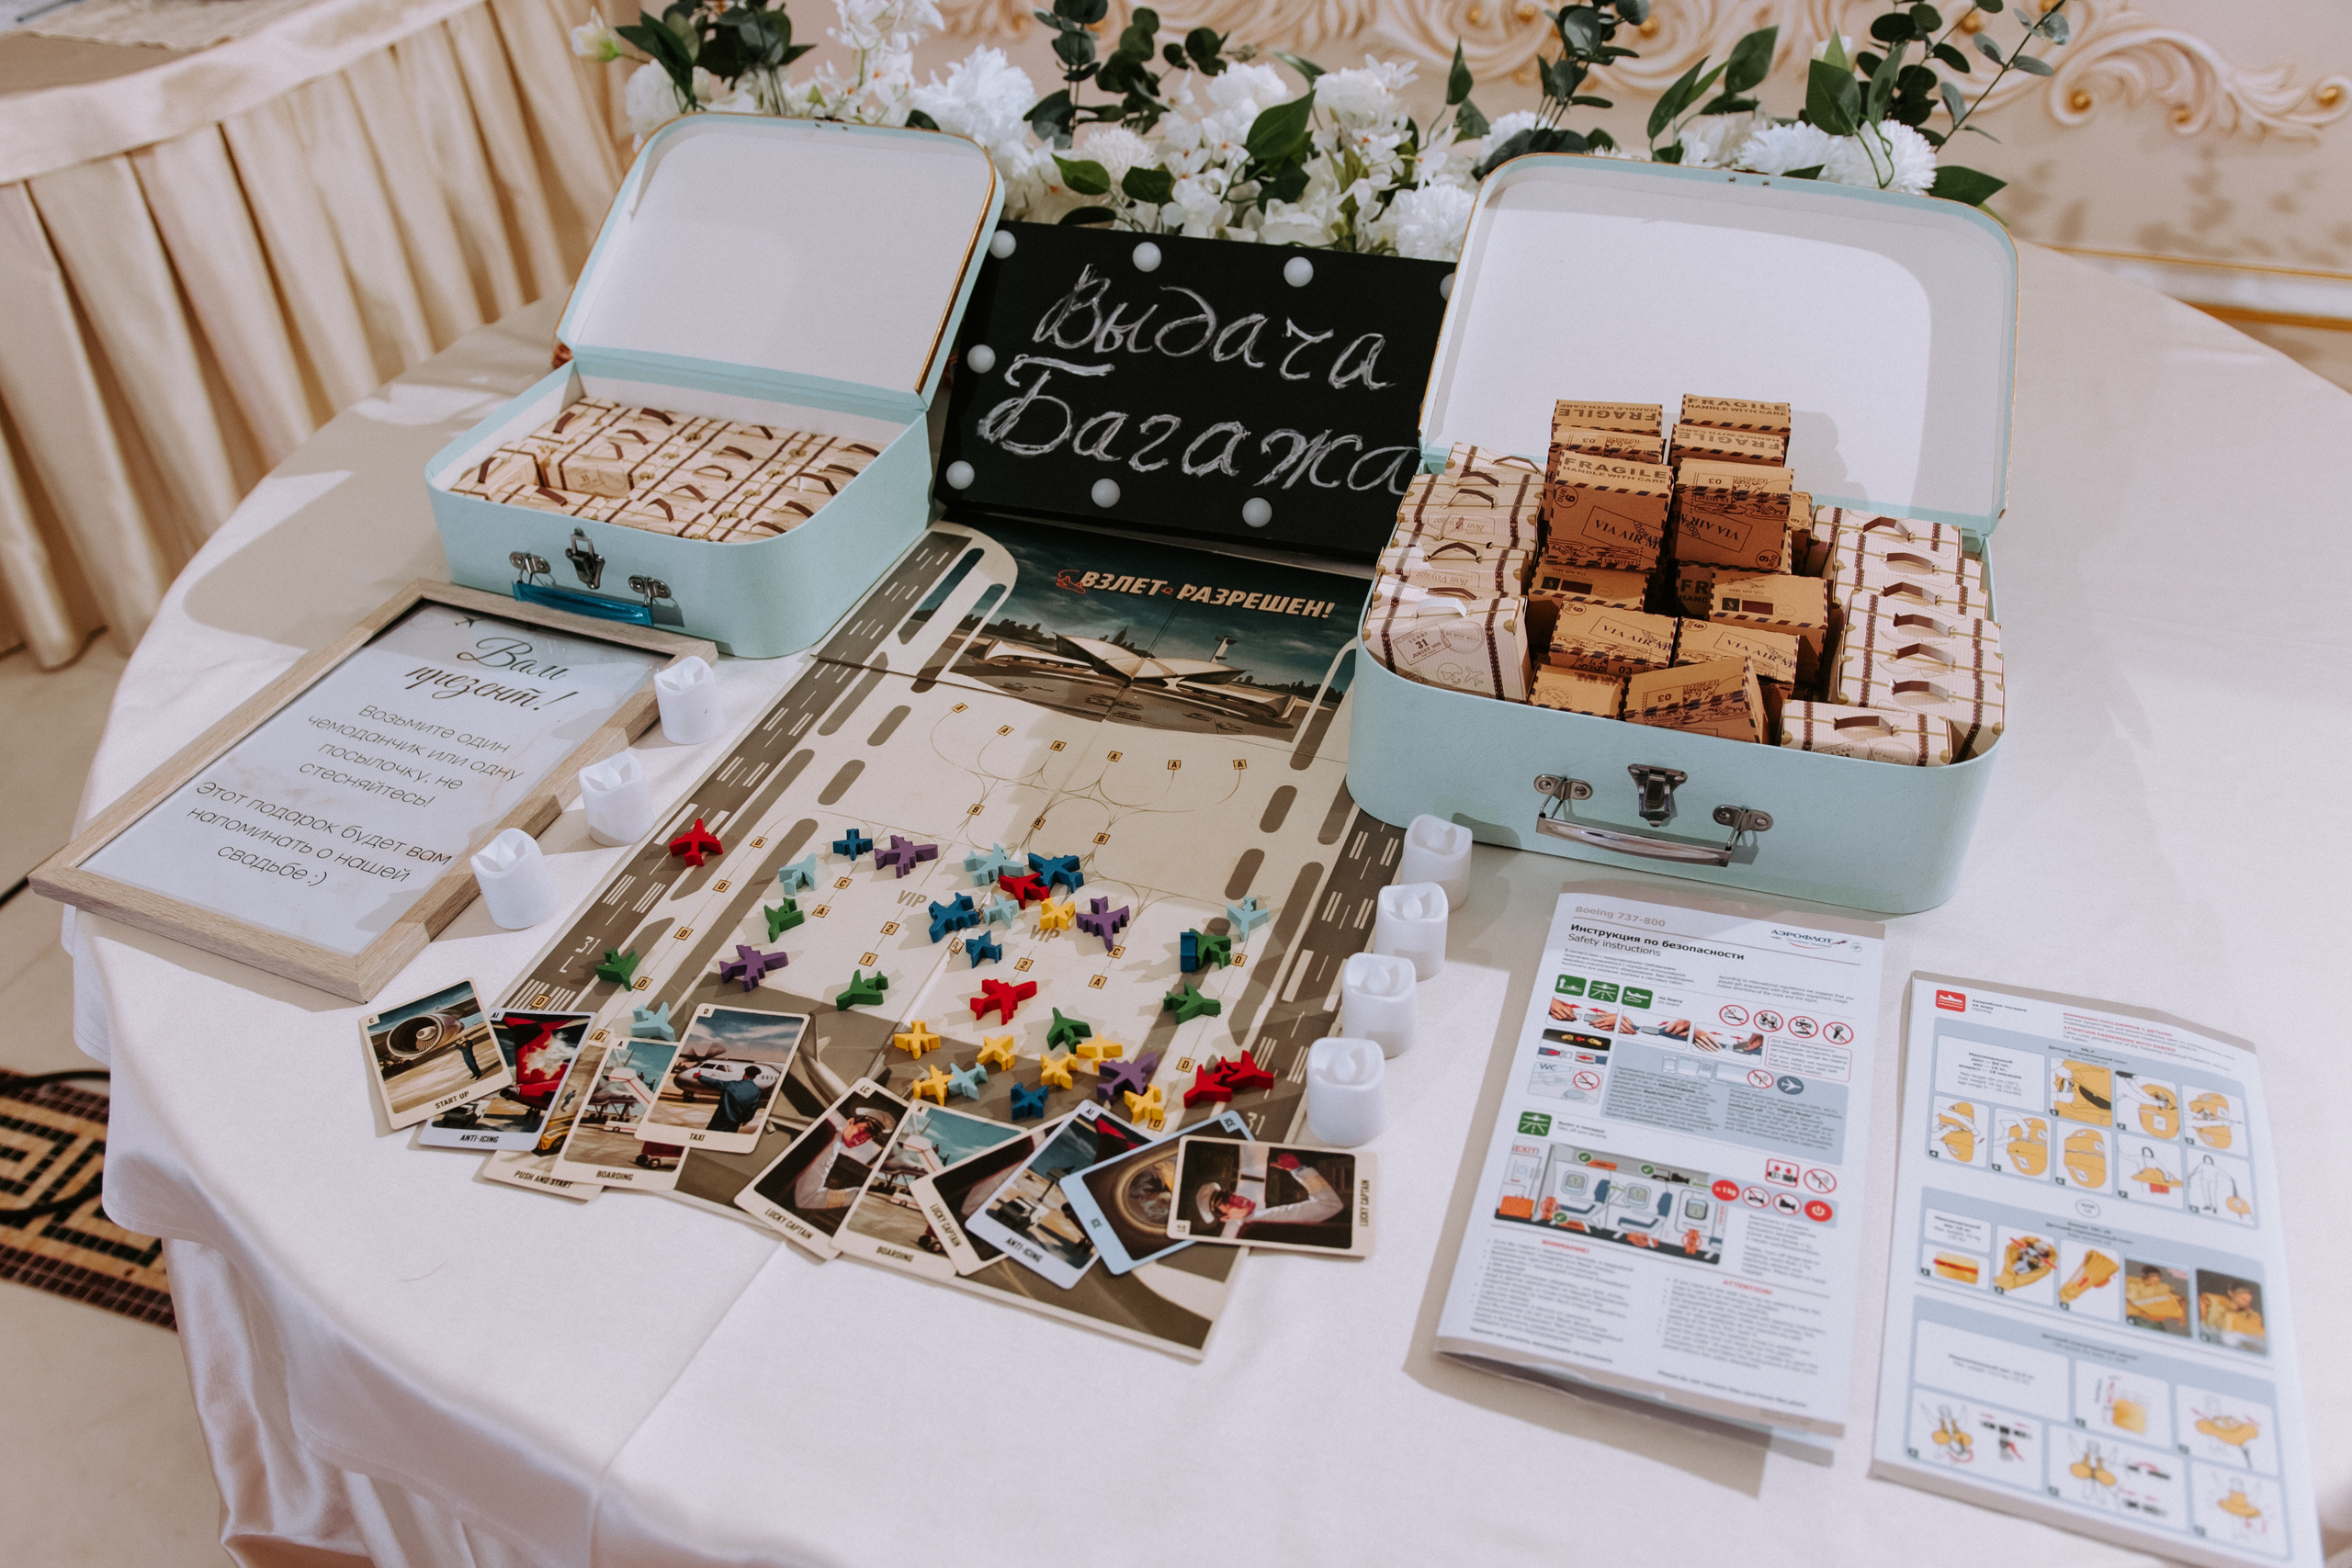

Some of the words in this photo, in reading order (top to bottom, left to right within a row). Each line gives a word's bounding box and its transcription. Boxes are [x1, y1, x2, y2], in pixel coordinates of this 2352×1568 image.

[1031, 262, 1397, 391] Выдача
[1687, 398, 1786, 412] FRAGILE
[1558, 408, 1657, 422] FRAGILE
[976, 353, 1420, 496] Багажа
[1679, 432, 1780, 450] FRAGILE
[1737, 434, 1780, 443] HANDLE
[1563, 466, 1606, 477] HANDLE
[1564, 457, 1667, 479] FRAGILE
[1556, 488, 1567, 502] DUE
[1467, 523, 1485, 532] Bon
[1595, 519, 1616, 535] VIA
[1618, 530, 1643, 544] AIR
[1717, 525, 1738, 540] VIA
[1768, 554, 1778, 568] DUE
[1415, 570, 1448, 583] Voyage
[1451, 576, 1469, 587] Bon
[1080, 570, 1169, 596] ВЗЛЕТ
[1176, 582, 1336, 619] РАЗРЕШЕН!
[1603, 625, 1624, 637] VIA
[1408, 631, 1428, 644] LUNDI
[1415, 638, 1429, 649] 31
[1726, 639, 1748, 651] VIA
[456, 636, 570, 681] Вам
[1618, 665, 1633, 675] 03
[1657, 693, 1671, 703] 03
[358, 704, 456, 740] Возьмите
[458, 730, 511, 754] один
[307, 715, 423, 757] чемоданчик
[426, 746, 469, 768] или
[469, 756, 525, 783] одну
[1054, 742, 1063, 750] A
[1110, 752, 1119, 761] A
[317, 740, 430, 784] посылочку,
[435, 774, 464, 791] не
[1170, 761, 1178, 769] A
[1237, 760, 1244, 768] A
[299, 762, 436, 808] стесняйтесь!
[971, 806, 980, 814] B
[196, 780, 248, 807] Этот
[244, 795, 336, 835] подарок
[340, 821, 402, 854] будет
[405, 844, 453, 865] вам
[1034, 817, 1043, 827] B
[755, 838, 763, 846] D
[1097, 834, 1106, 842] B
[186, 806, 313, 855] напоминать
[315, 846, 334, 861] о
[335, 852, 413, 884] нашей
[718, 882, 728, 890] D
[839, 879, 848, 887] C
[896, 889, 928, 908] VIP
[817, 907, 826, 915] A
[1575, 905, 1614, 919] Boeing
[1617, 912, 1666, 927] 737-800
[679, 929, 689, 938] D
[886, 924, 894, 932] 2
[1570, 923, 1641, 943] Инструкция
[1644, 938, 1658, 946] по
[1661, 940, 1745, 961] безопасности
[1770, 929, 1834, 943] АЭРОФЛОТ
[1567, 933, 1600, 947] Safety
[1602, 939, 1661, 957] instructions
[1112, 948, 1121, 956] C
[1020, 961, 1028, 969] 2
[1234, 955, 1242, 964] D
[638, 979, 648, 987] D
[1092, 977, 1102, 987] A
[537, 997, 545, 1005] D
[595, 1032, 605, 1040] D
[1181, 1060, 1190, 1069] D
[1539, 1063, 1557, 1071] WC
[859, 1084, 870, 1094] LC
[435, 1096, 458, 1110] START
[458, 1090, 469, 1100] UP
[459, 1134, 500, 1144] ANTI-ICING
[689, 1133, 705, 1142] TAXI
[514, 1170, 533, 1181] PUSH
[534, 1174, 550, 1184] AND
[549, 1177, 574, 1189] START
[595, 1170, 634, 1181] BOARDING
[1359, 1179, 1371, 1203] CAPTAIN
[1358, 1204, 1369, 1226] LUCKY
[764, 1207, 786, 1224] LUCKY
[785, 1221, 813, 1240] CAPTAIN
[929, 1202, 945, 1224] LUCKY
[942, 1223, 963, 1248] CAPTAIN
[876, 1245, 915, 1262] BOARDING
[1005, 1236, 1044, 1262] ANTI-ICING
